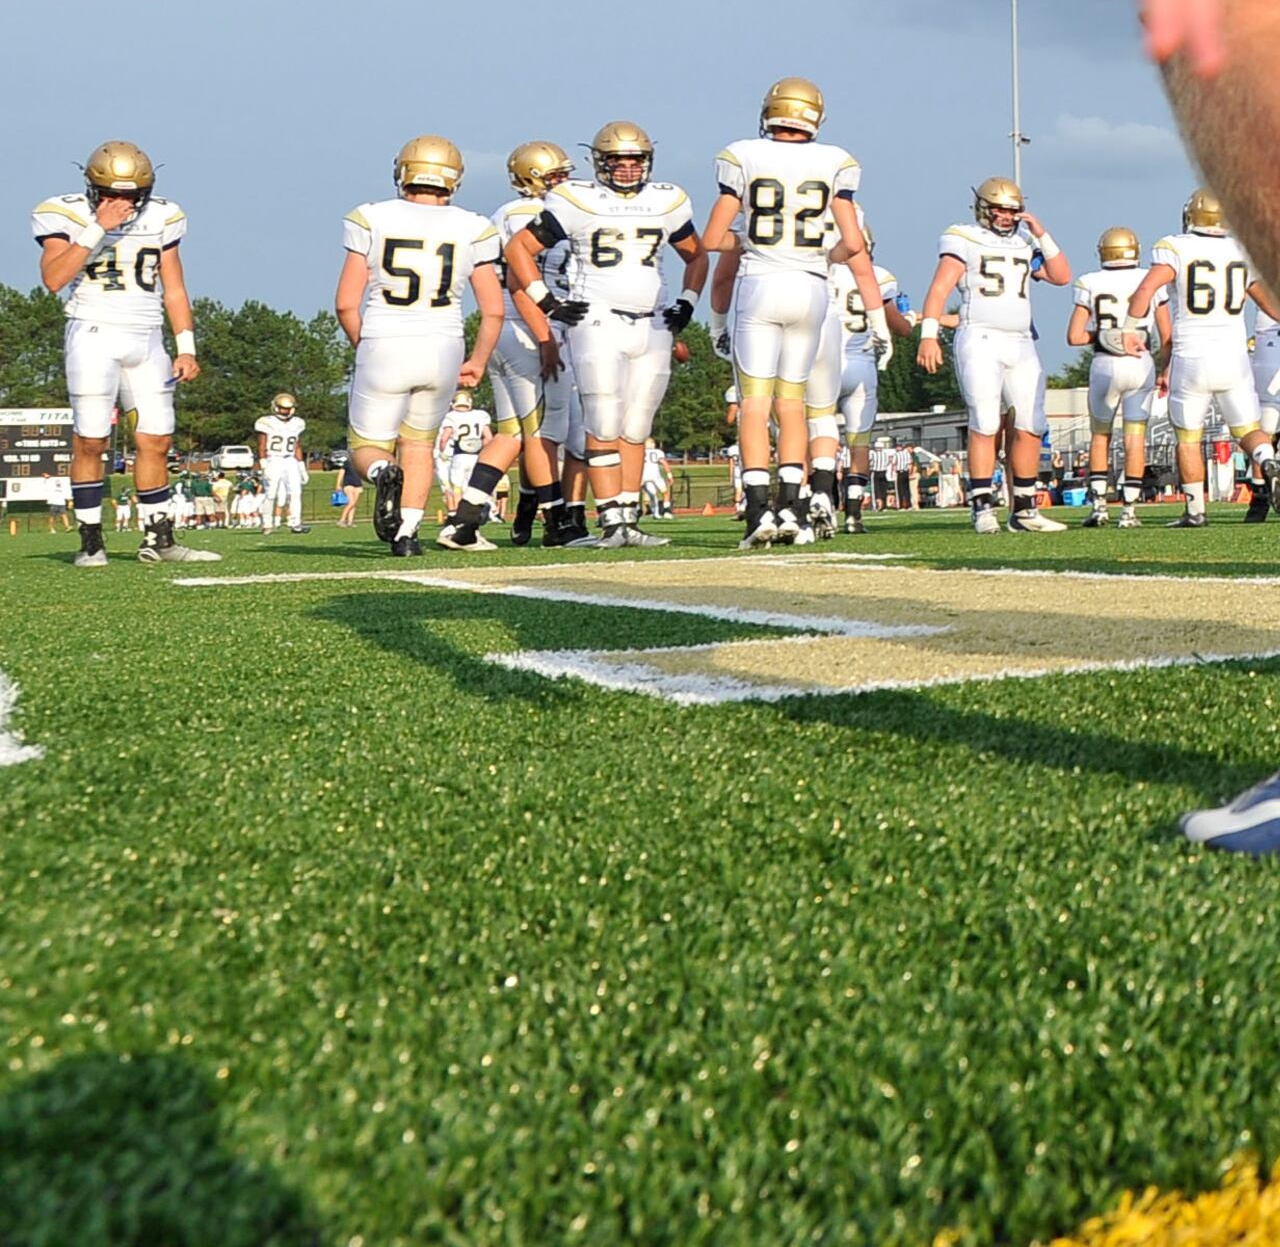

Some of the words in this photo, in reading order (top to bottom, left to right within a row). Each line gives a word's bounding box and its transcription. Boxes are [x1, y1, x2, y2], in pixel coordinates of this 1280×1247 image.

[749, 178, 831, 247] 82
[86, 246, 161, 292] 40
[590, 227, 664, 268] 67
[382, 238, 455, 307] 51
[979, 255, 1029, 299] 57
[1187, 260, 1248, 315] 60
[270, 435, 297, 452] 28
[457, 423, 480, 441] 21
